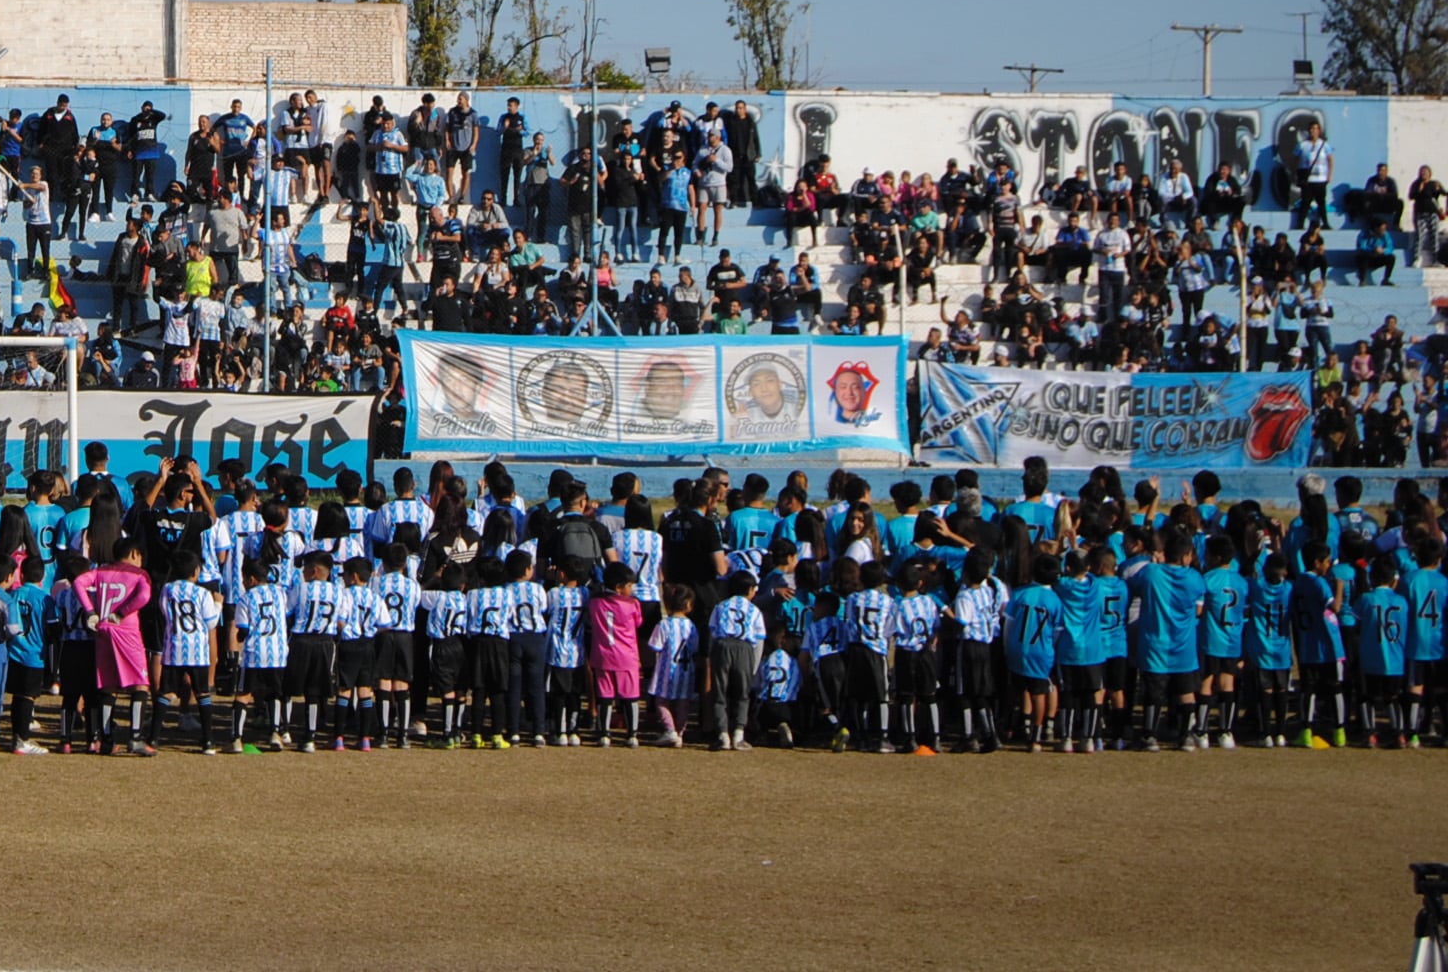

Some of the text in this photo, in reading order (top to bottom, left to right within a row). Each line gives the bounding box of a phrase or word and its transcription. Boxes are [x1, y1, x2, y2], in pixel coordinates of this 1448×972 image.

[1044, 382, 1106, 415] QUE
[921, 390, 1008, 445] ARGENTINO
[1010, 411, 1082, 448] SINO
[1083, 418, 1143, 453] QUE
[126, 399, 356, 483] José
[633, 551, 649, 580] 7
[170, 599, 197, 634] 18
[258, 601, 276, 637] 5
[384, 592, 404, 628] 8
[562, 607, 583, 639] 17
[730, 607, 745, 640] 3
[1020, 603, 1049, 645] 17
[1102, 595, 1121, 631] 5
[1374, 605, 1401, 644] 16
[1417, 590, 1441, 628] 4
